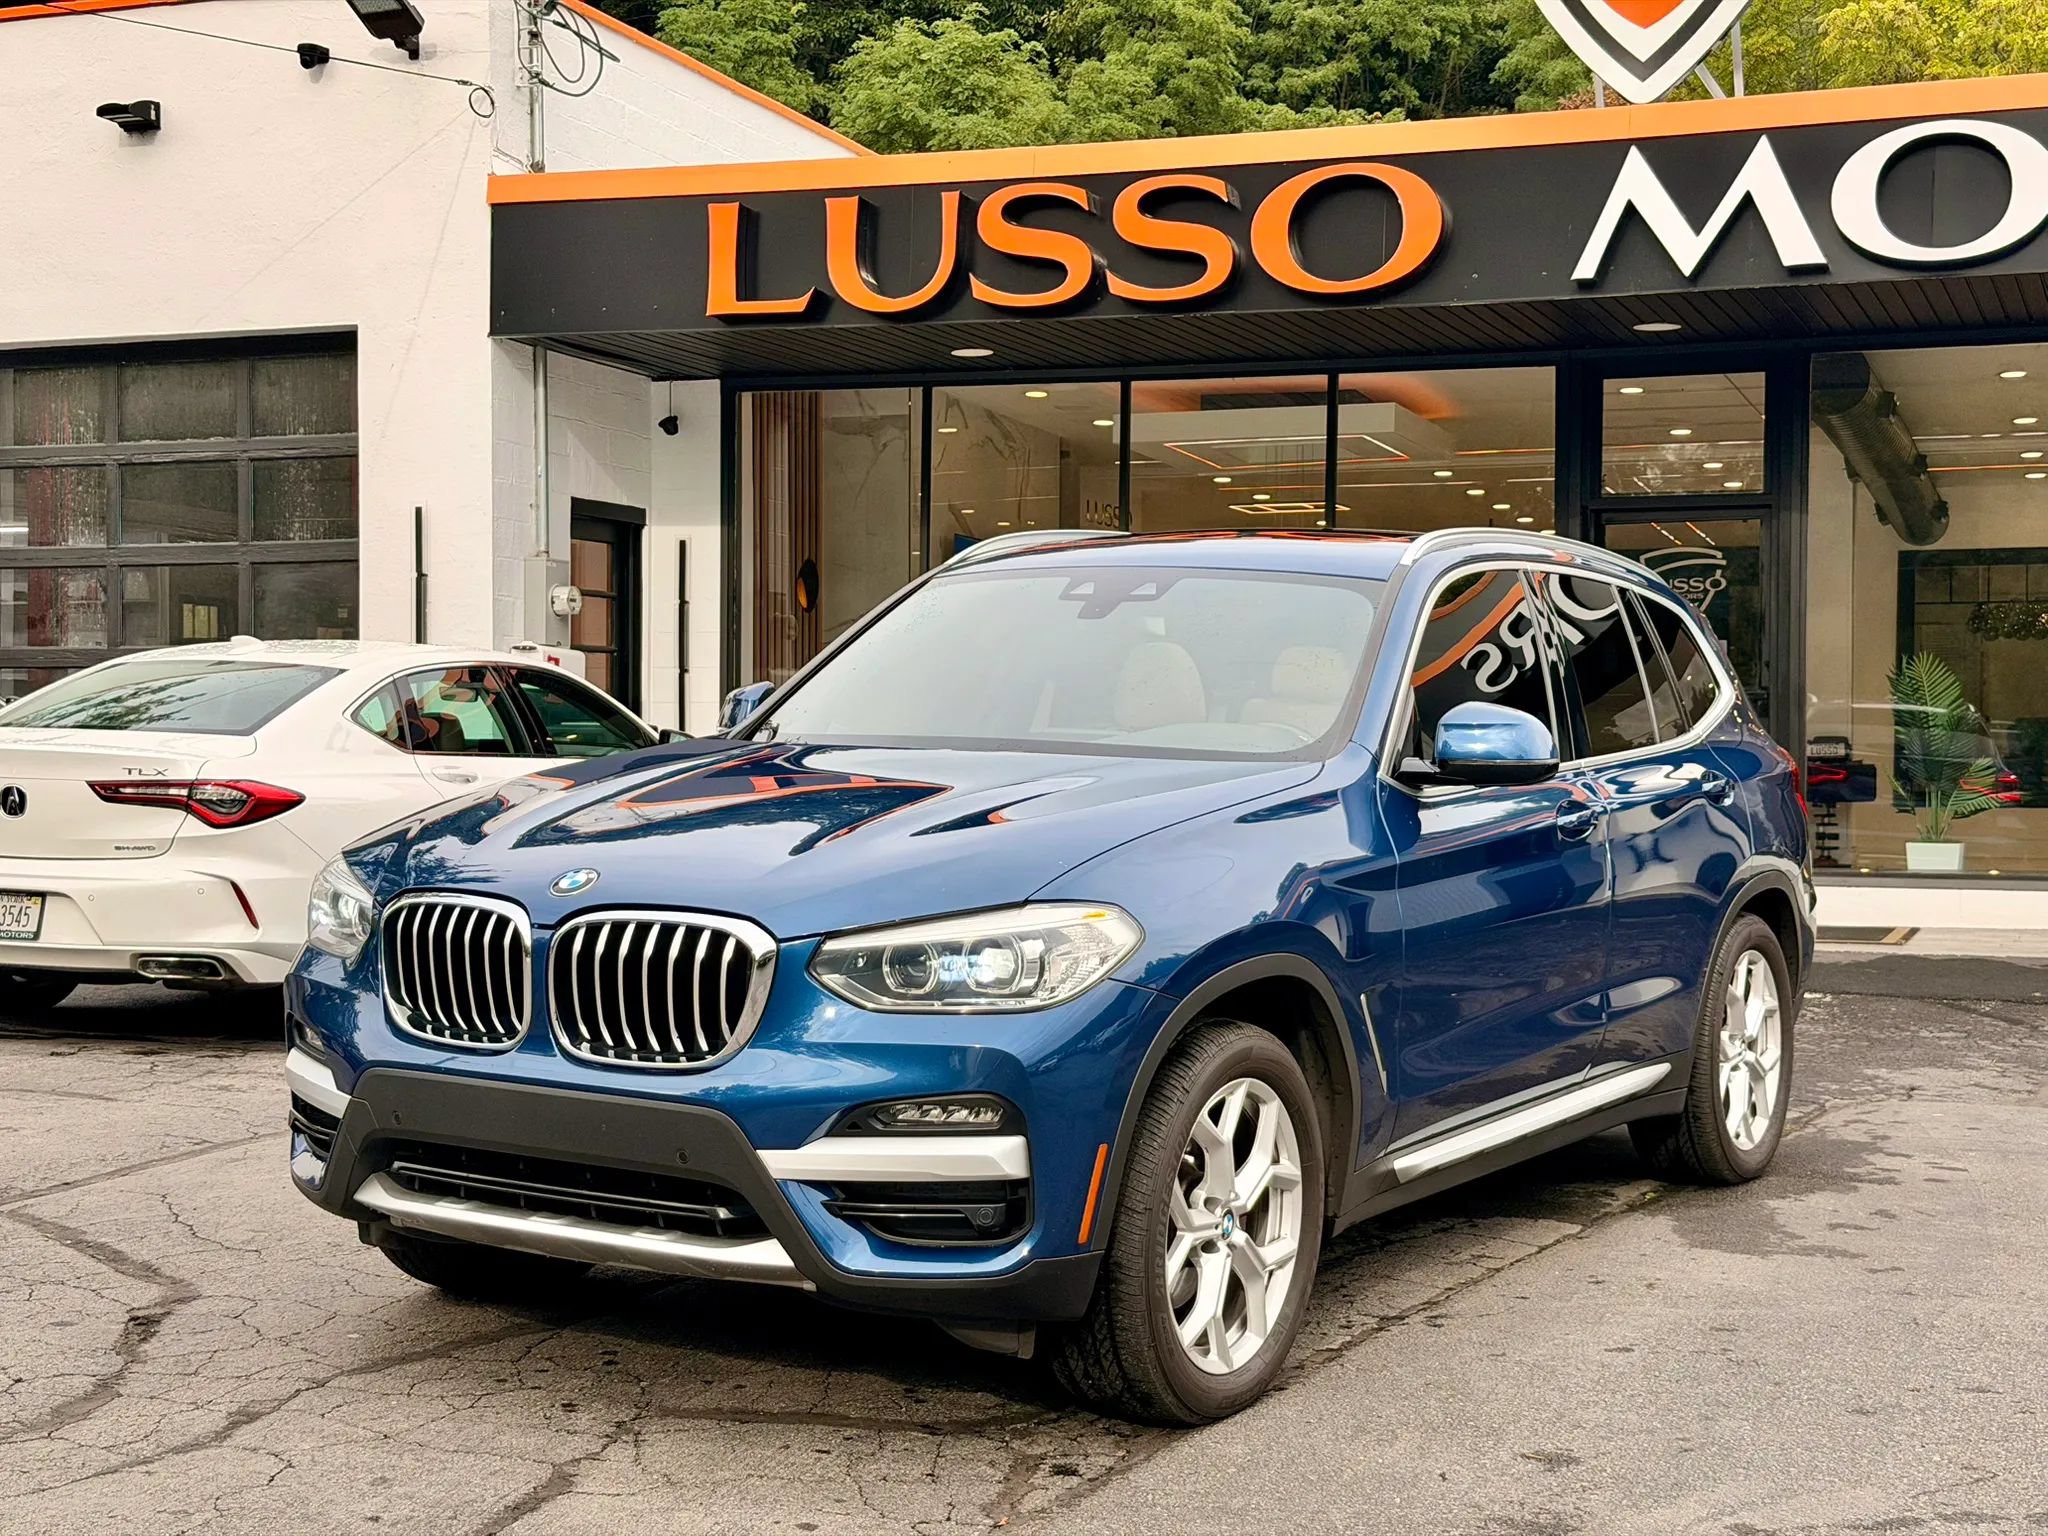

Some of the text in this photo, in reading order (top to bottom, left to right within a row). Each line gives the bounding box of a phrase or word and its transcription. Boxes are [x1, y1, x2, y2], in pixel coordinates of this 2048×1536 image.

[705, 119, 2048, 317] LUSSO MO
[121, 767, 168, 776] TLX
